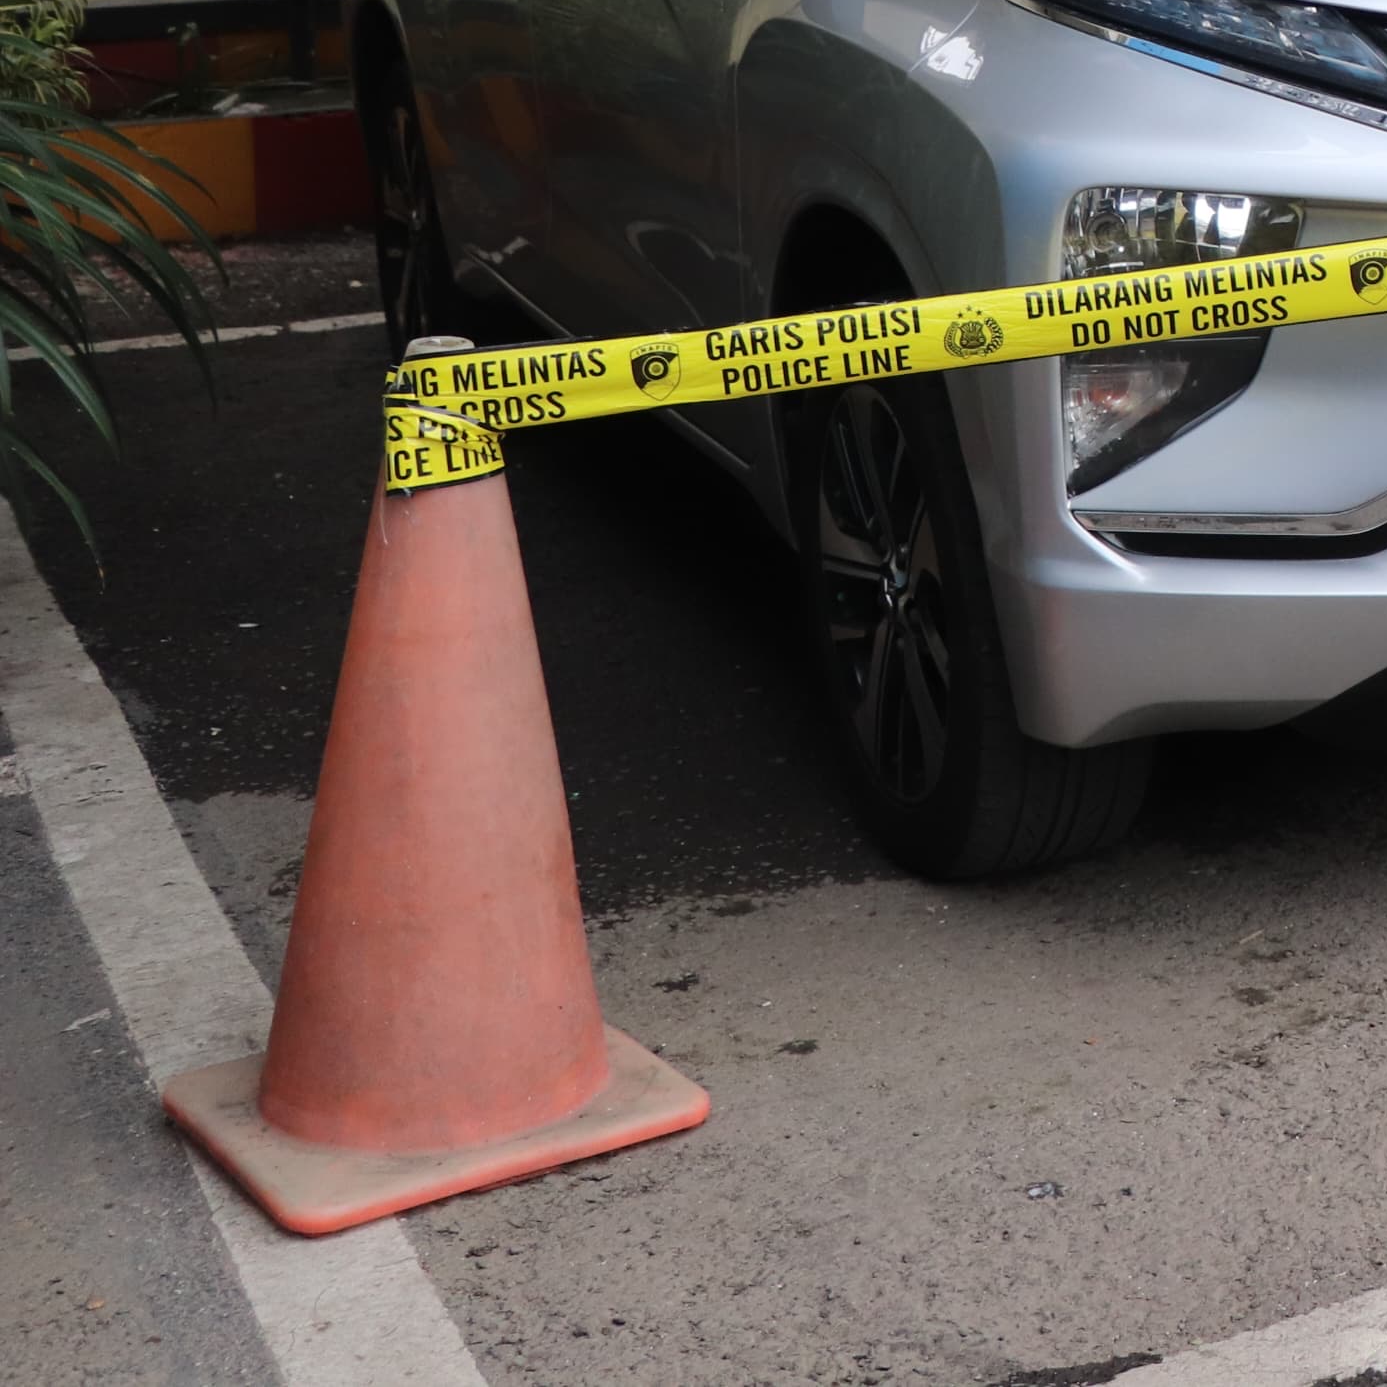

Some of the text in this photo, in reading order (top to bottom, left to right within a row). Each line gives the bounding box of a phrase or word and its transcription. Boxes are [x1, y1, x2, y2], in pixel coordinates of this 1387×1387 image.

[1025, 253, 1328, 321] DILARANG MELINTAS
[705, 305, 923, 362] GARIS POLISI
[1072, 295, 1289, 349] DO NOT CROSS
[452, 347, 608, 394] MELINTAS
[722, 345, 913, 396] POLICE LINE
[460, 391, 567, 426] CROSS
